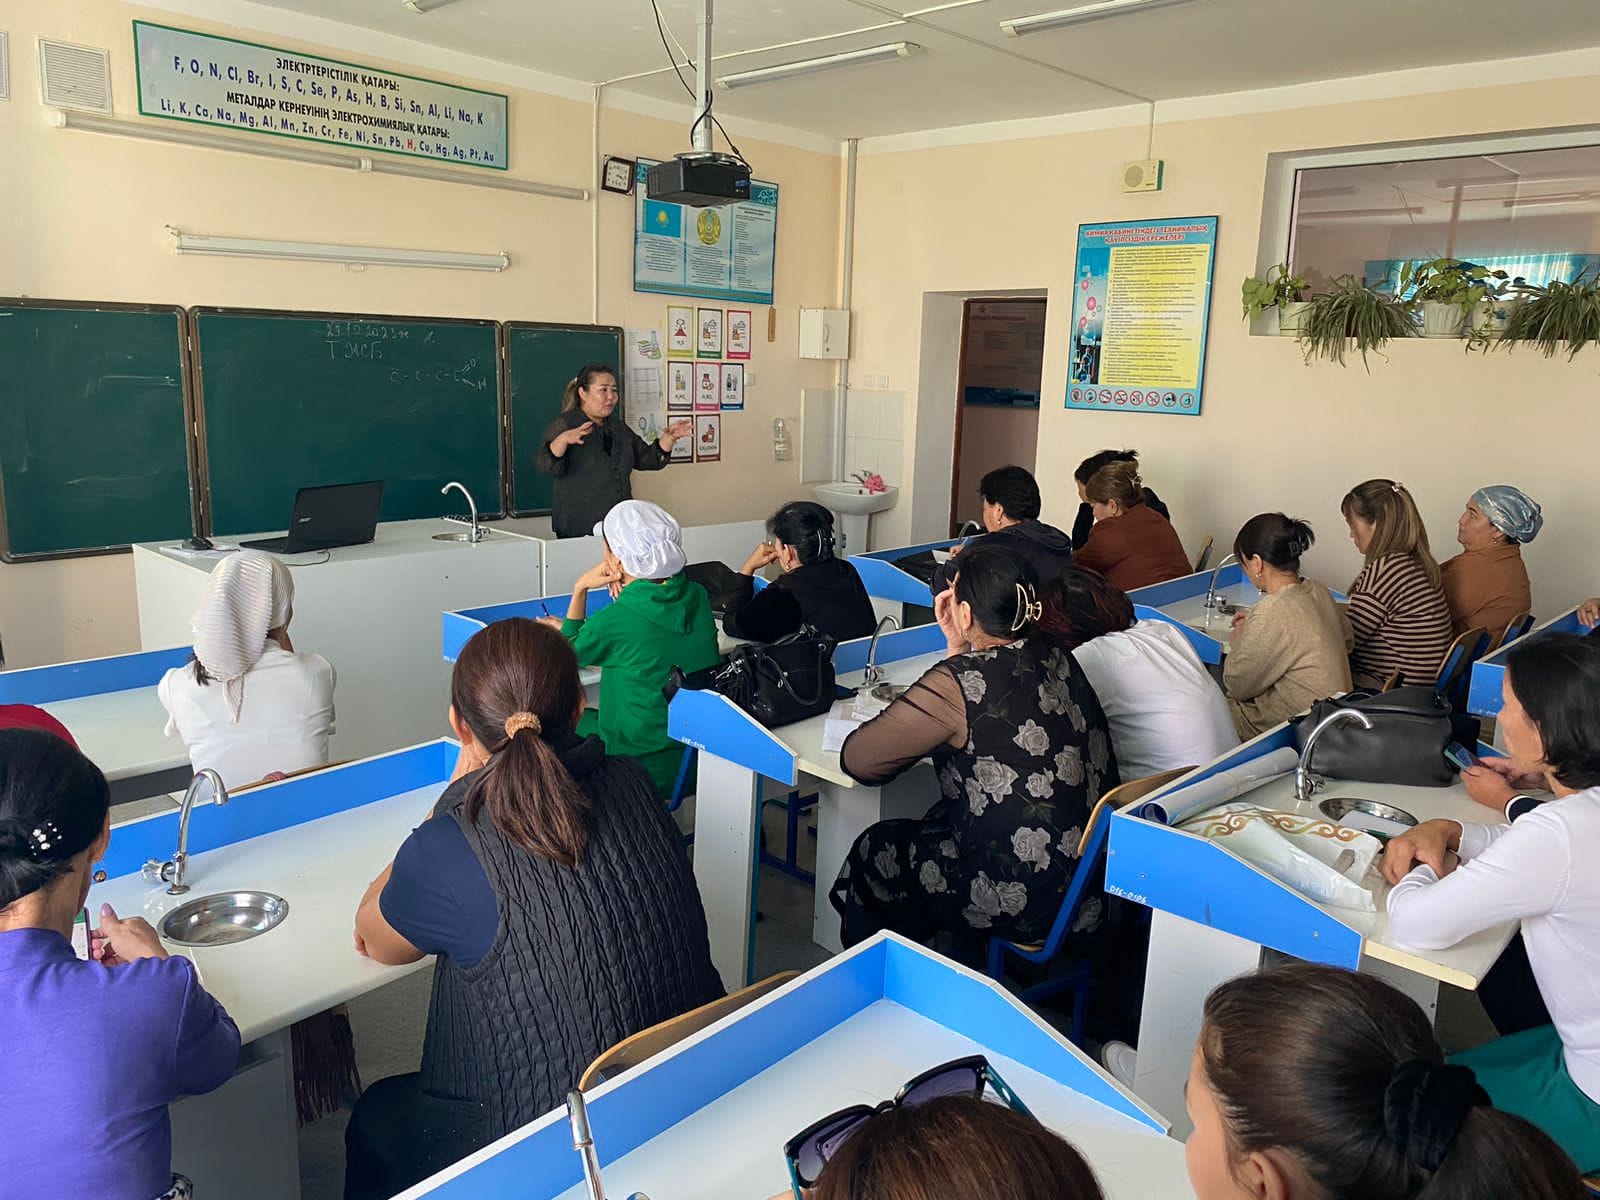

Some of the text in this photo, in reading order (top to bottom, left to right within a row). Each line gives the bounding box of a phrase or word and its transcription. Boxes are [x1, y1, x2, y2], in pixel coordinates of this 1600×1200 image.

[276, 58, 400, 92] ЭЛЕКТРТЕРІСТІЛІК ҚАТАРЫ:
[227, 91, 450, 139] МЕТАЛДАР КЕРНЕУІНІҢ ЭЛЕКТРОХИМИЯЛЫҚ ҚАТАРЫ:
